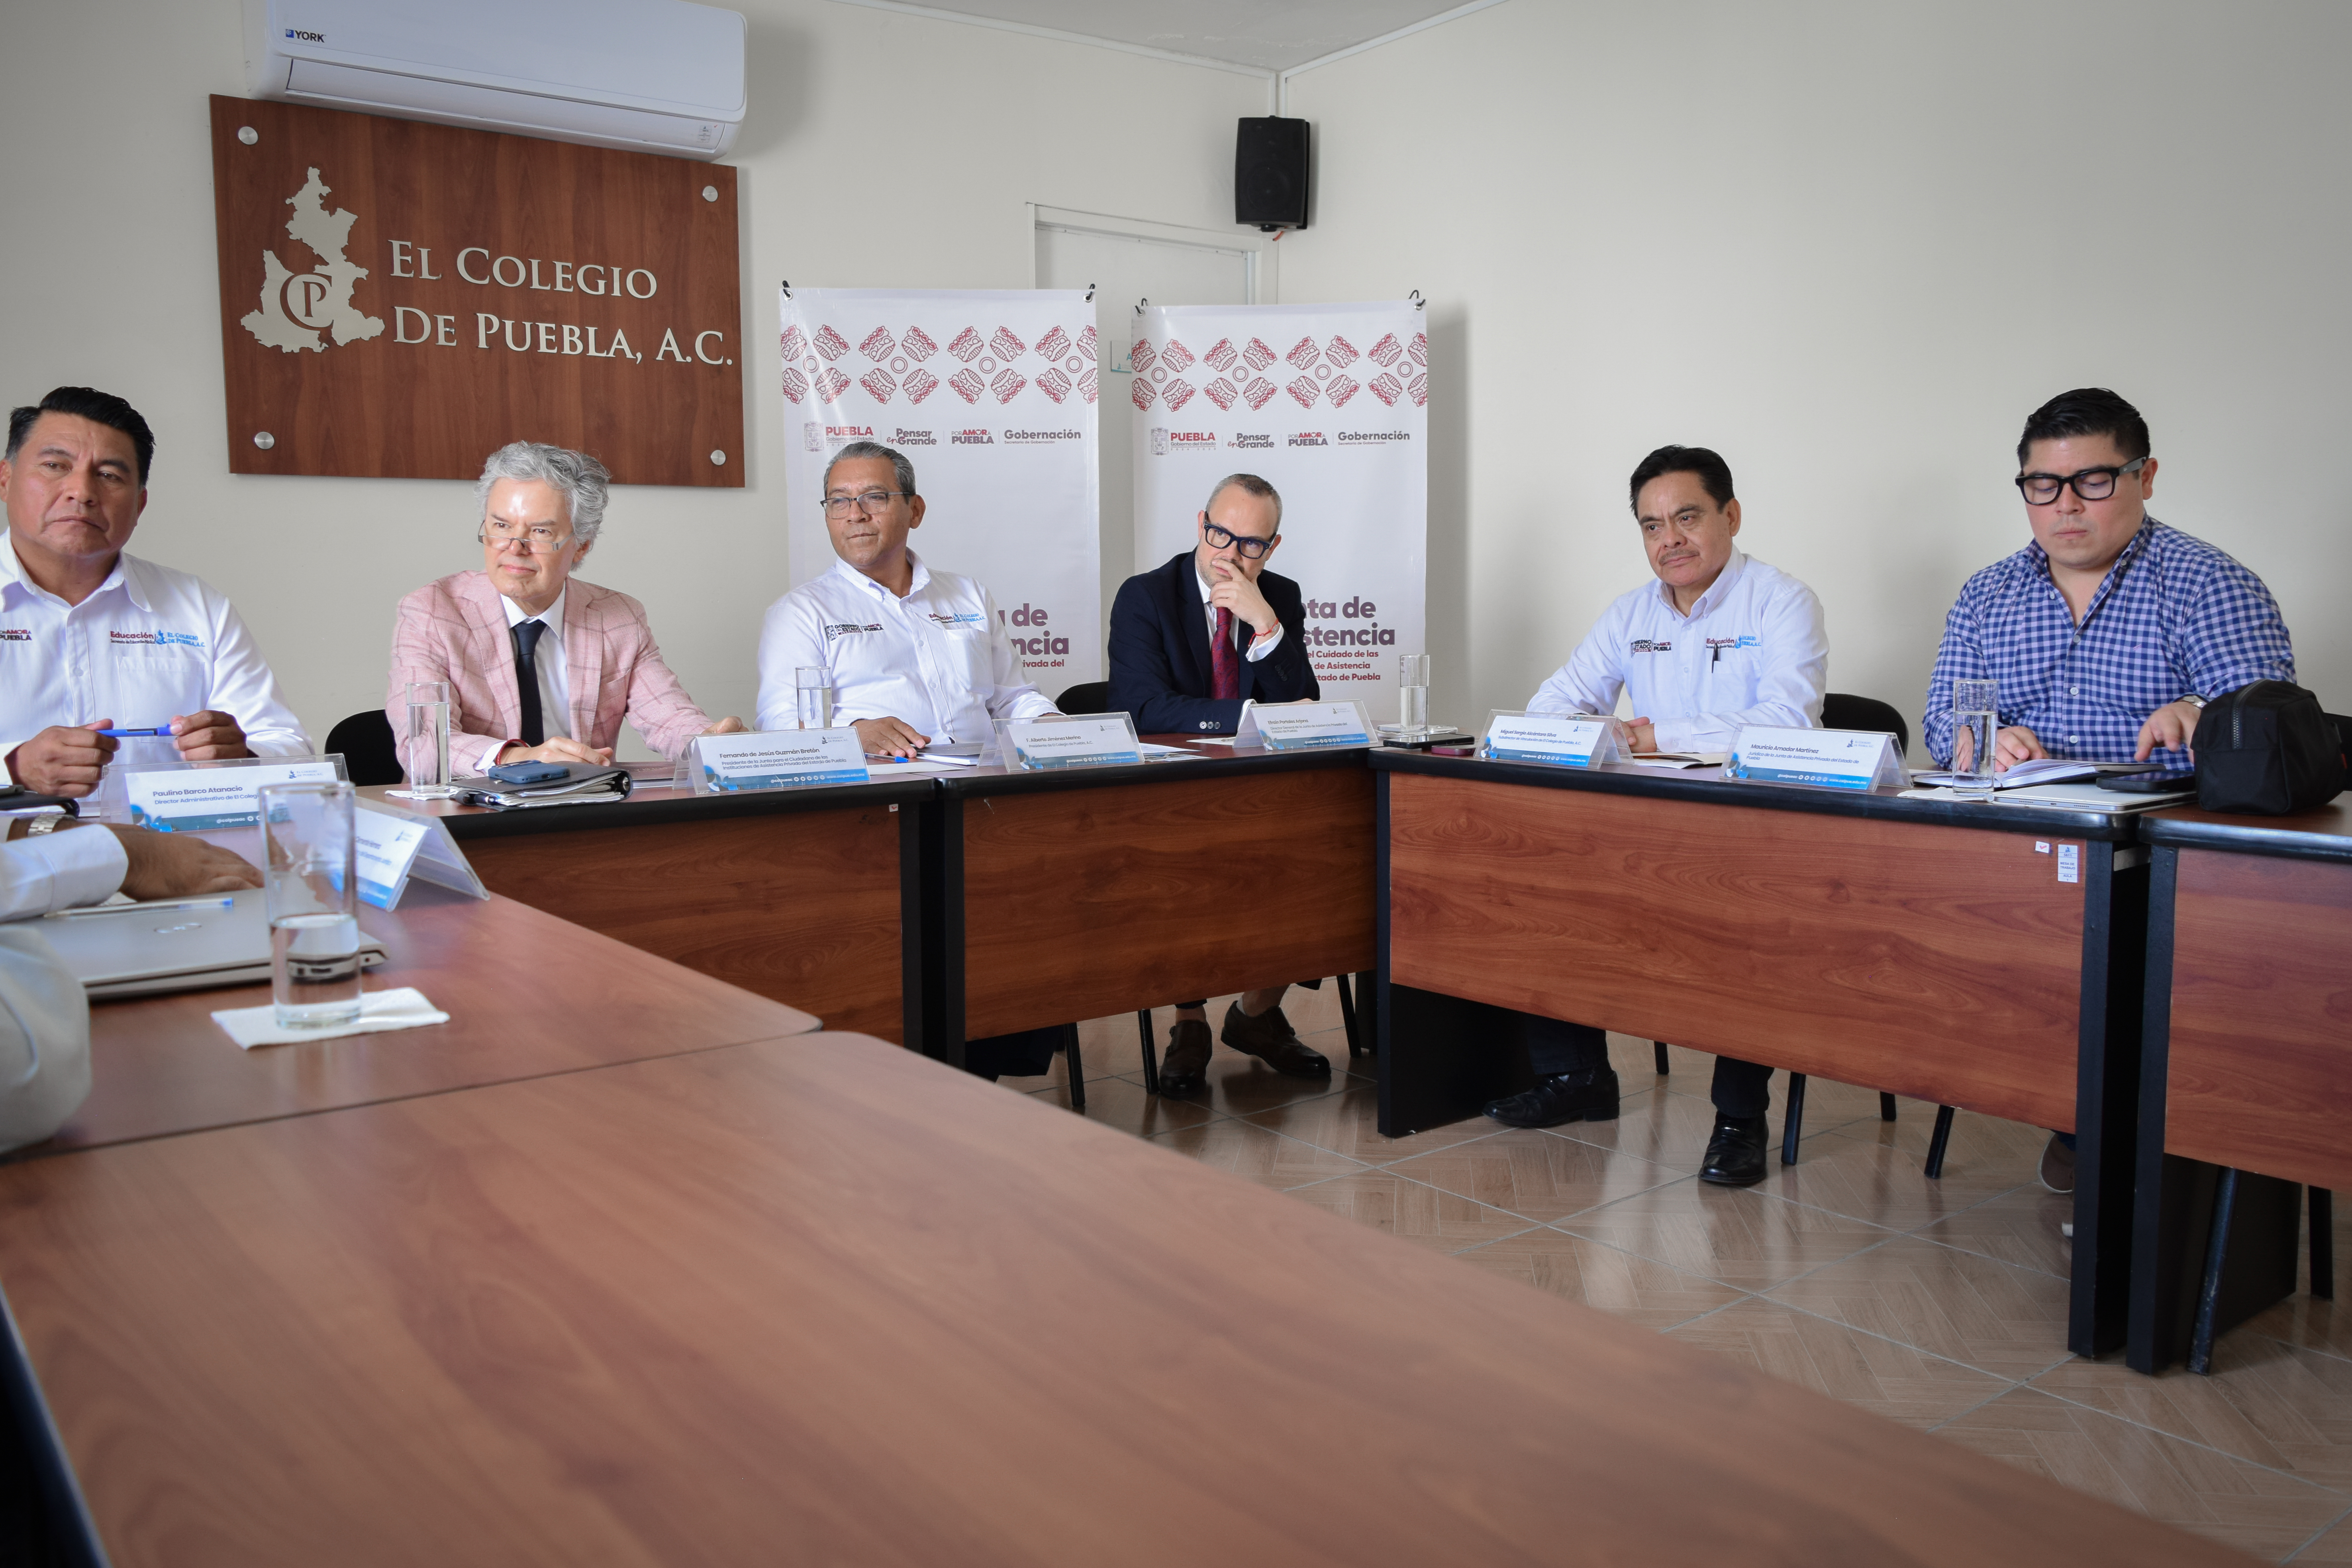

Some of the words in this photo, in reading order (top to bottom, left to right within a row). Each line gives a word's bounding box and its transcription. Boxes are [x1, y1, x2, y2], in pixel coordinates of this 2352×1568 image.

[295, 30, 325, 43] YORK
[456, 247, 658, 300] COLEGIO
[393, 306, 457, 347] DE
[476, 313, 642, 365] PUEBLA,
[656, 327, 733, 366] A.C.
[826, 426, 874, 436] PUEBLA
[896, 428, 932, 437] Pensar
[1004, 429, 1081, 439] Gobernación
[1338, 431, 1410, 441] Gobernación
[898, 436, 937, 445] Grande
[1171, 432, 1216, 441] PUEBLA
[1238, 440, 1274, 448] Grande
[1342, 596, 1376, 618] de
[1011, 603, 1048, 627] de
[1304, 622, 1395, 646] stencia
